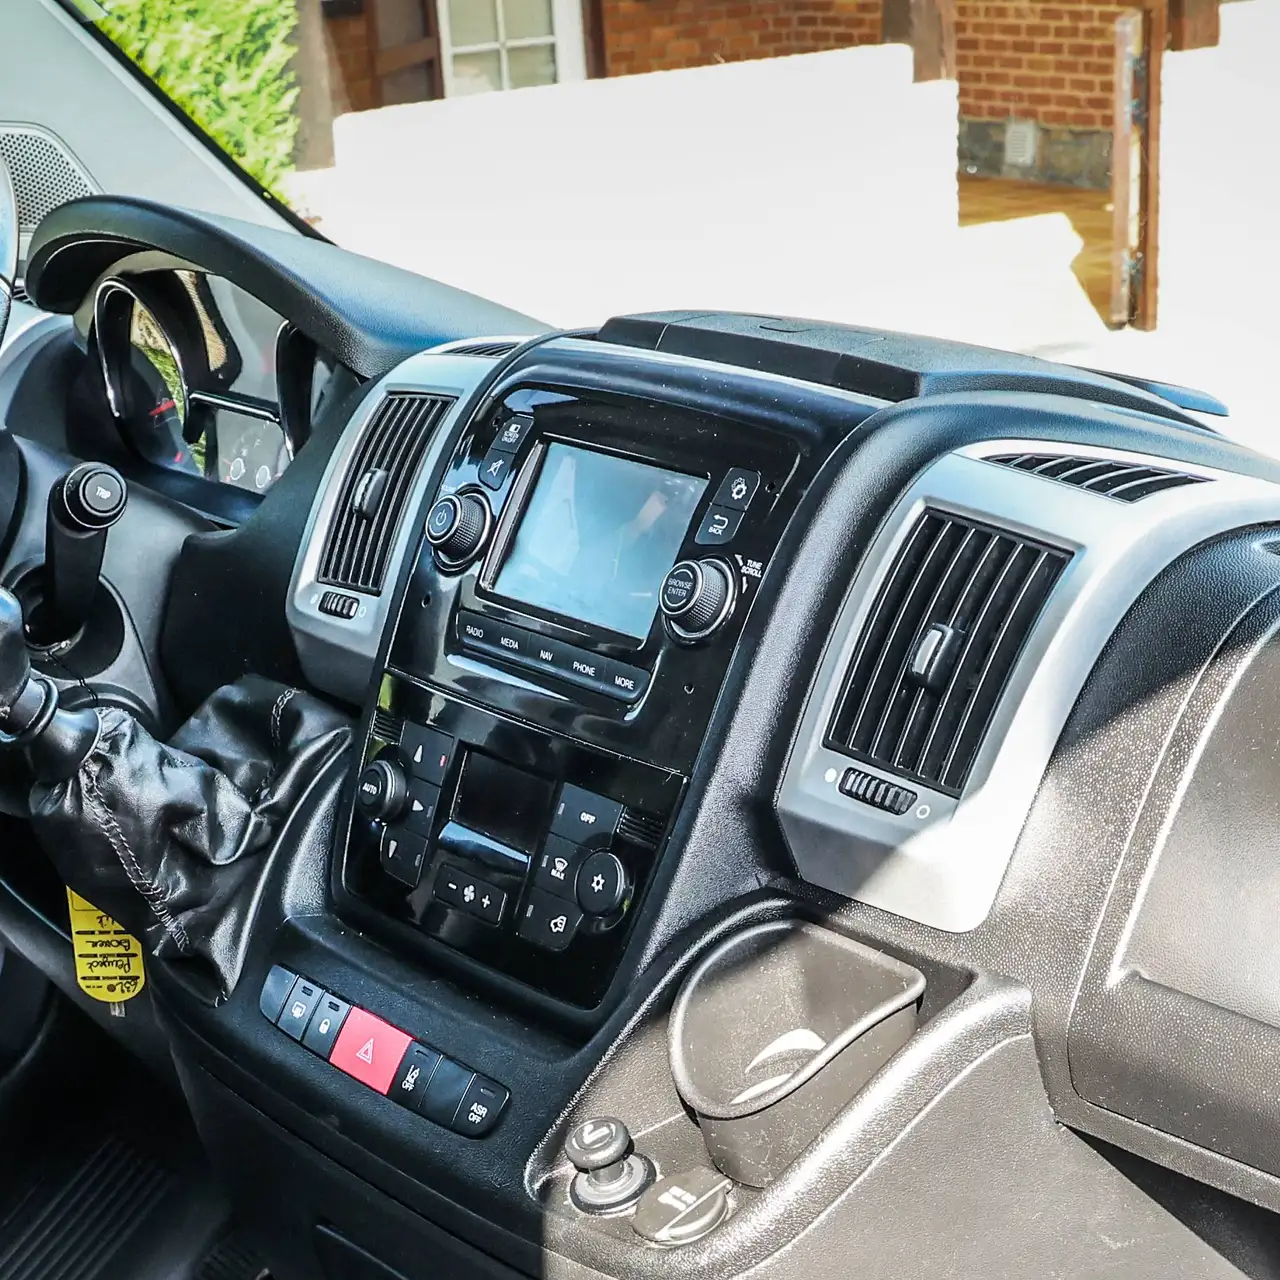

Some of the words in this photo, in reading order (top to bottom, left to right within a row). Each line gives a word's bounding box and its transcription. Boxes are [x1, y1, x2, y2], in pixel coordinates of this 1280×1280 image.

[96, 486, 111, 499] TRIP
[708, 526, 723, 536] BACK
[746, 559, 762, 570] TUNE
[740, 565, 762, 578] SCROLL
[667, 577, 693, 590] BROWSE
[667, 586, 687, 598] ENTER
[466, 625, 484, 638] RADIO
[500, 636, 519, 650] MEDIA
[539, 650, 554, 662] NAV
[573, 661, 596, 677] PHONE
[615, 675, 634, 690] MORE
[362, 782, 377, 795] AUTO
[580, 811, 596, 824] OFF
[550, 868, 566, 880] MAX
[401, 1080, 415, 1092] OFF
[470, 1102, 488, 1117] ASR
[468, 1112, 482, 1124] OFF
